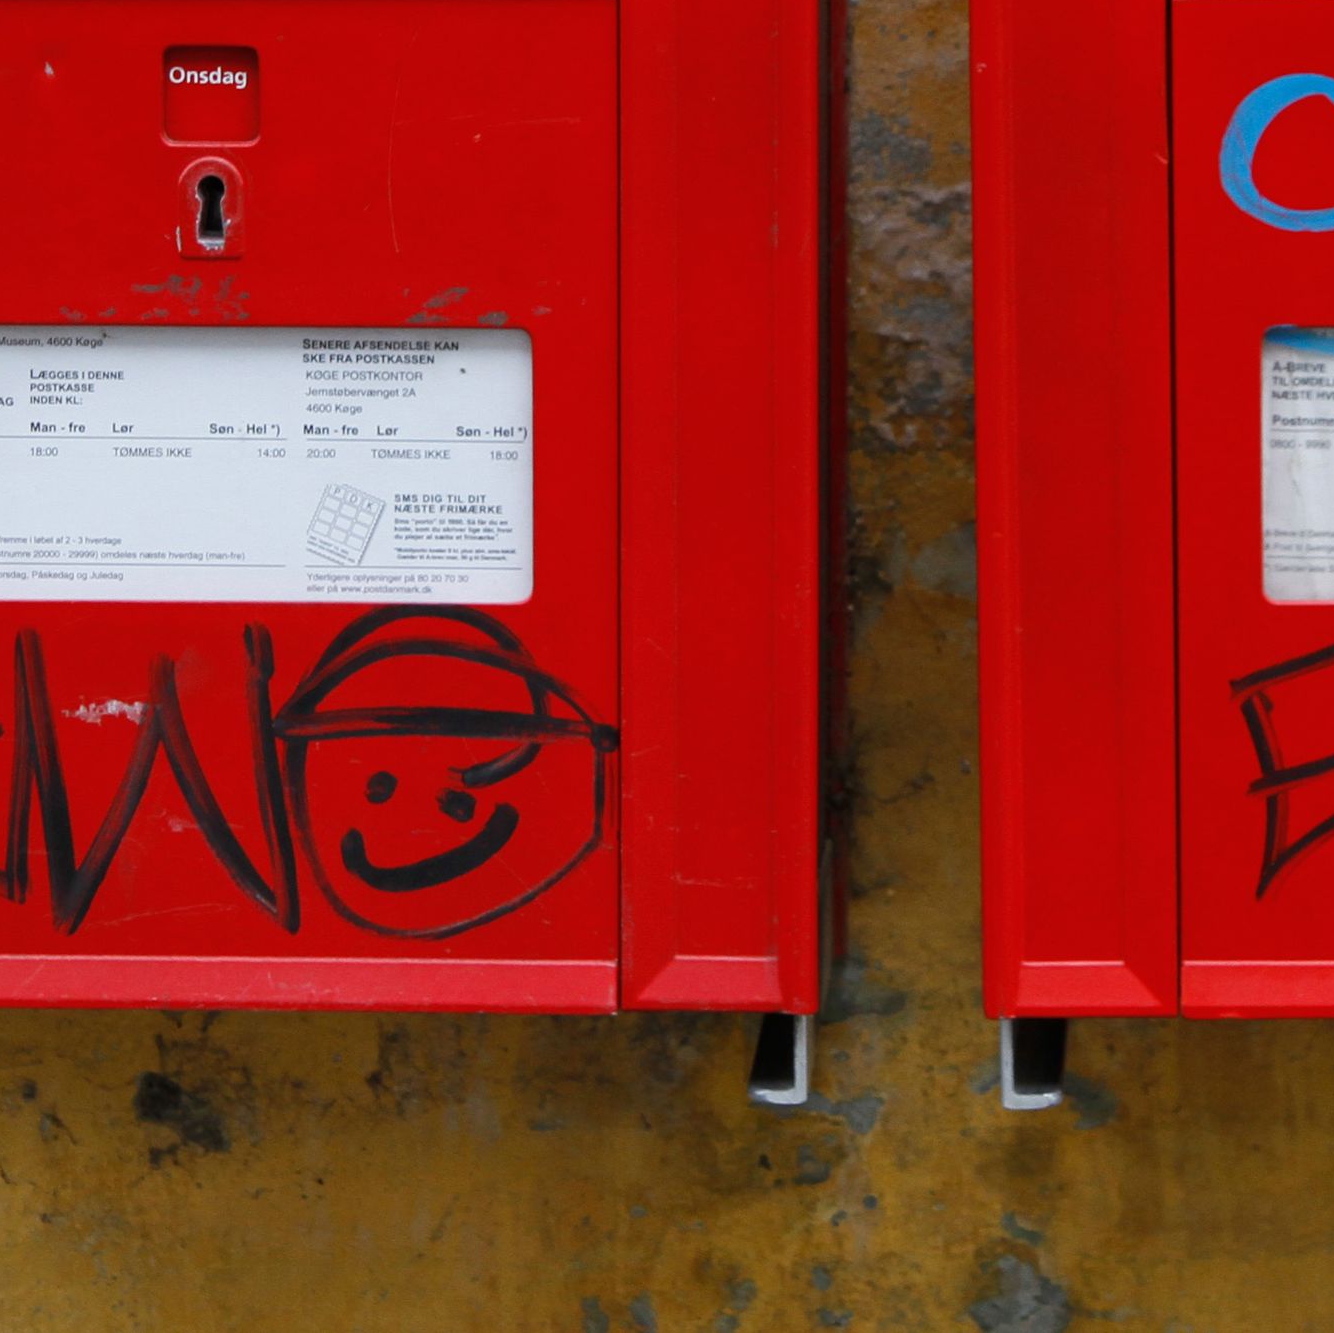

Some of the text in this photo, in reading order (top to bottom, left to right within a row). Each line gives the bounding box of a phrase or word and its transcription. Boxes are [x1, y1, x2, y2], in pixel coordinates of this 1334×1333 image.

[169, 67, 247, 89] Onsdag
[47, 337, 72, 346] 4600
[76, 337, 103, 348] Køge
[303, 339, 459, 350] SENERE AFSENDELSE KAN
[303, 354, 435, 364] SKE FRA POSTKASSEN
[30, 370, 78, 379] LÆGGES
[88, 371, 123, 379] DENNE
[306, 371, 422, 381] KØGE POSTKONTOR
[30, 384, 94, 392] POSTKASSE
[403, 388, 416, 397] 2A
[30, 396, 62, 405] INDEN
[306, 404, 362, 415] 4600 Køge
[31, 423, 54, 433] Man
[69, 423, 85, 433] fre
[113, 423, 134, 434] Lør
[210, 424, 233, 434] Søn
[246, 424, 267, 434] Hel
[304, 425, 329, 435] Man
[342, 425, 358, 435] fre
[377, 426, 398, 435] Lør
[456, 427, 480, 437] Søn
[494, 427, 513, 437] Hel
[31, 447, 57, 457] 18:00
[113, 448, 191, 457] TØMMES IKKE
[258, 448, 286, 458] 14:00
[307, 449, 335, 458] 20:00
[371, 449, 450, 459] TØMMES IKKE
[490, 451, 518, 460] 18:00
[394, 505, 502, 513] NÆSTE FRIMÆRKE
